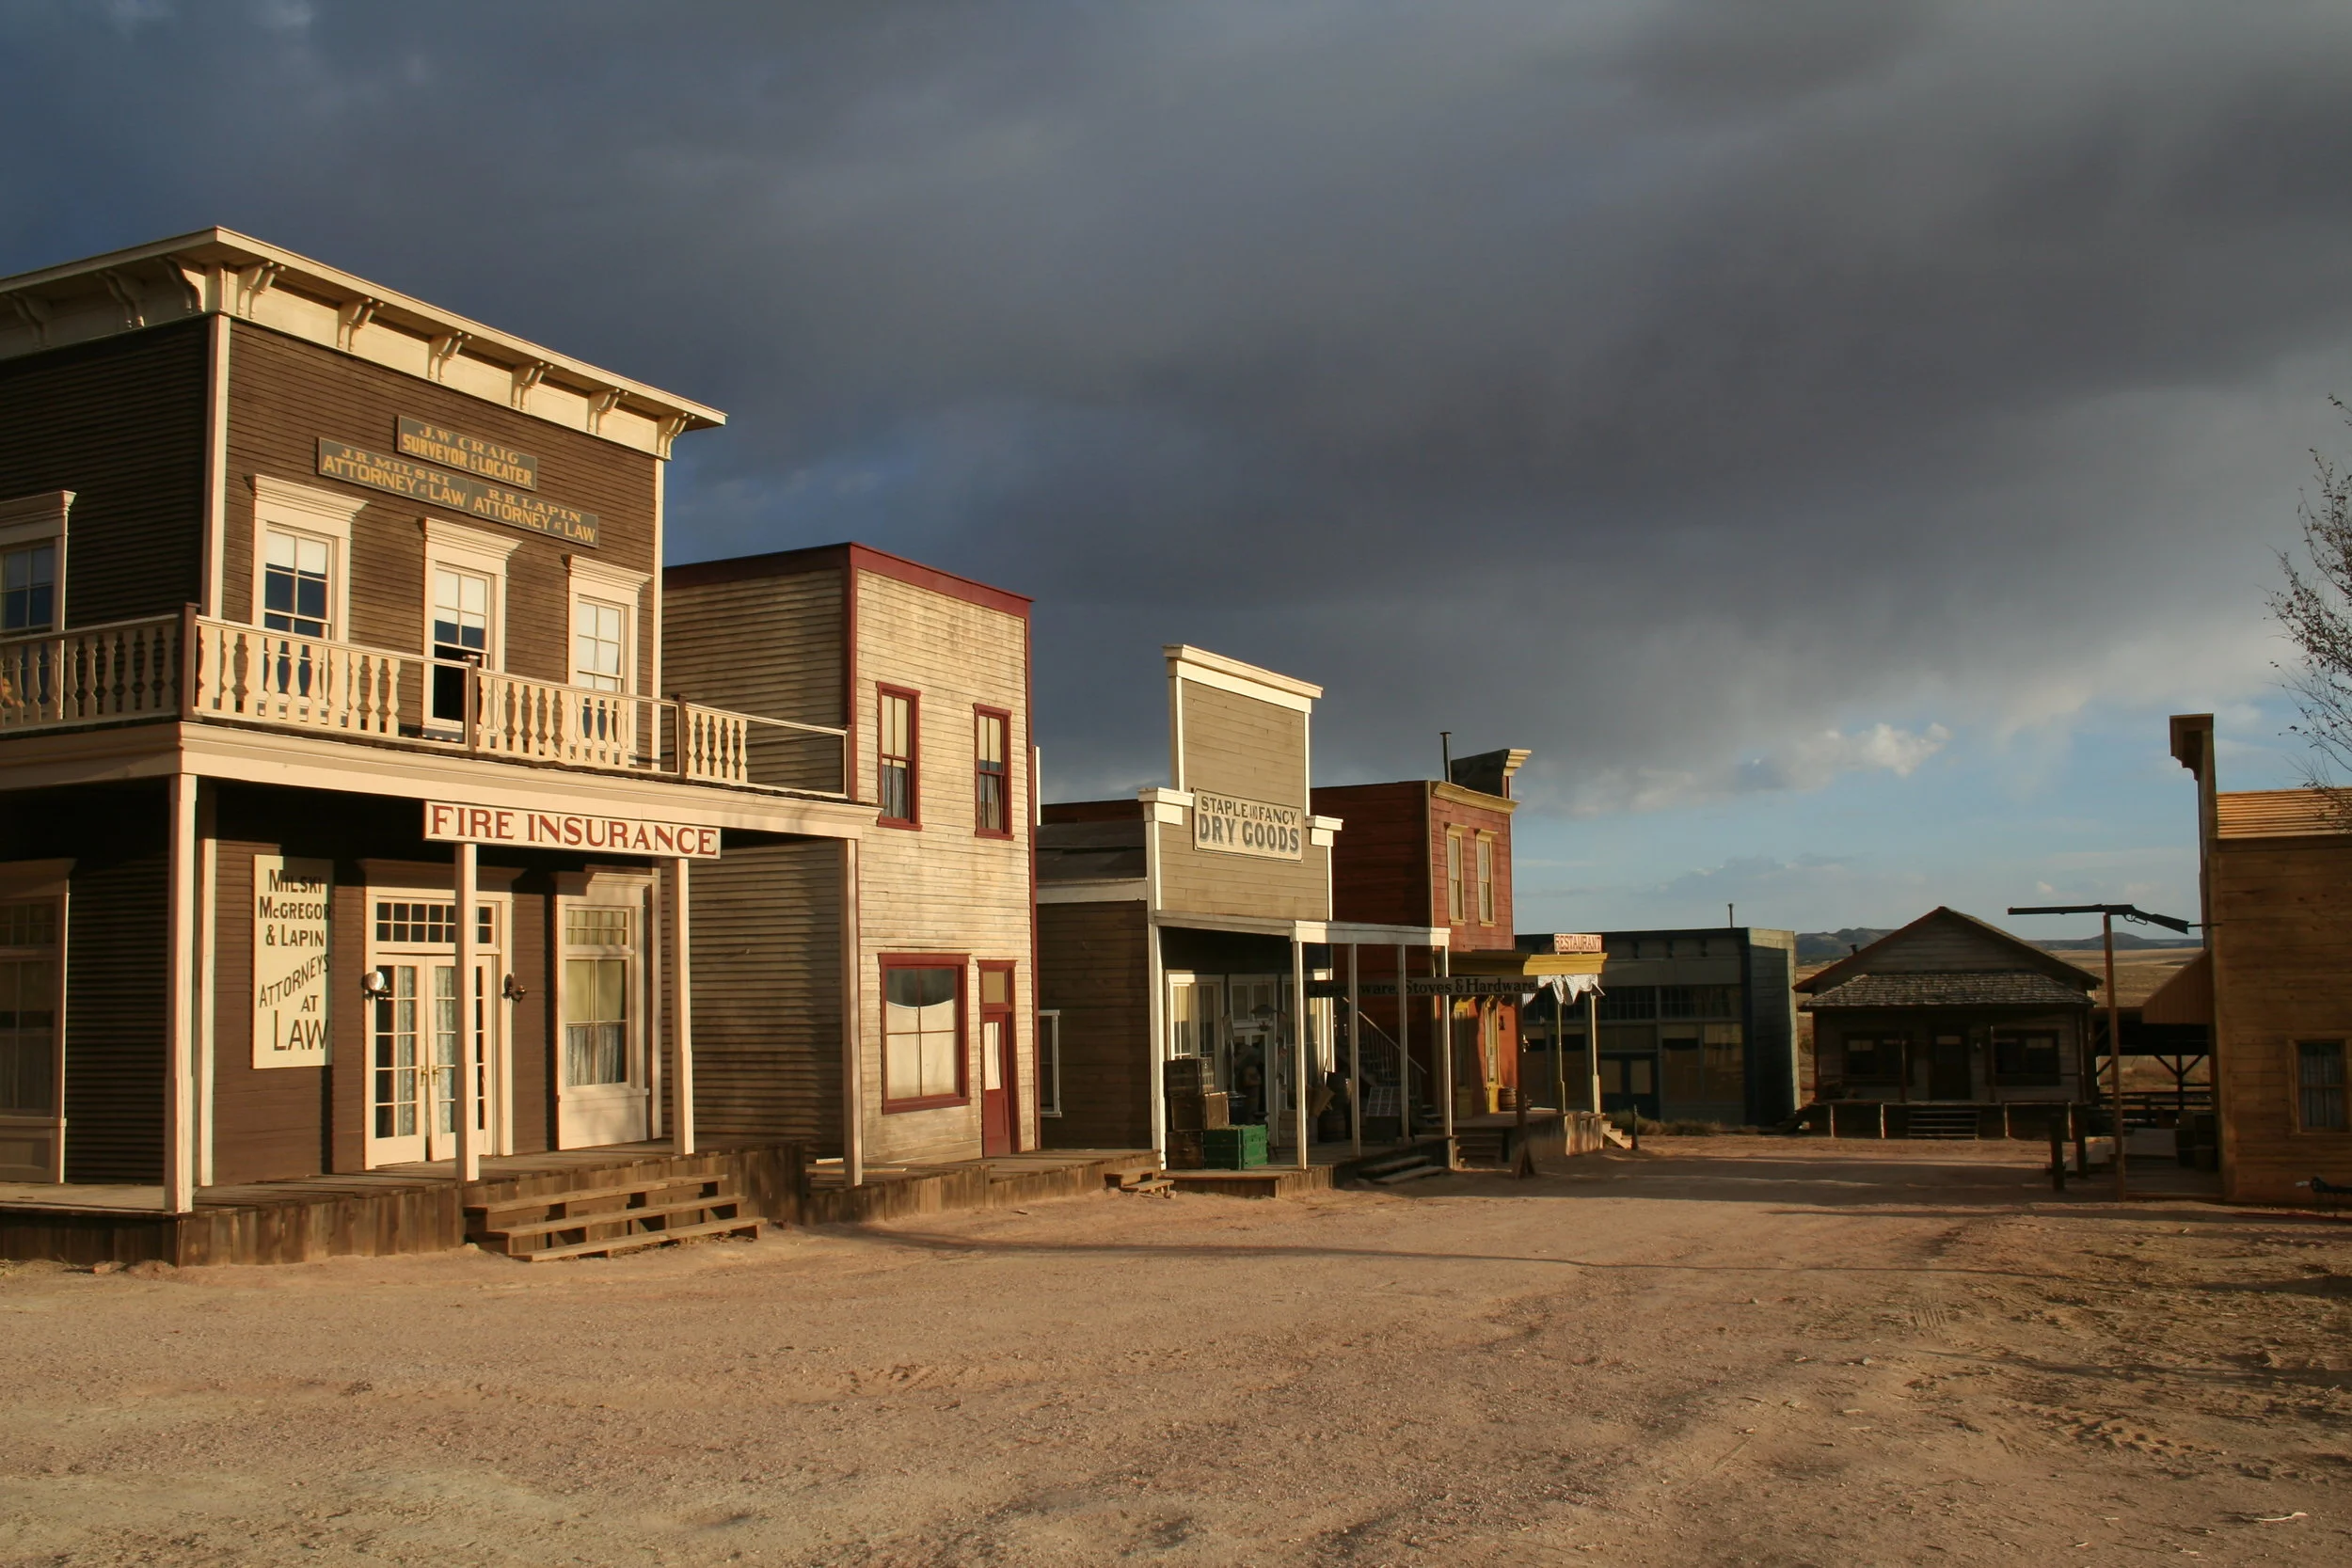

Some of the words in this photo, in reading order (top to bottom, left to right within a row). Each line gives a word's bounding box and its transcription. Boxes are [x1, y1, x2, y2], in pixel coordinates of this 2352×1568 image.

[402, 433, 468, 467] SURVEYOR
[478, 456, 533, 487] LOCATER
[458, 436, 519, 465] CRAIG
[322, 454, 417, 494] ATTORNEY
[429, 483, 467, 507] LAW
[374, 457, 450, 486] MILSKI
[473, 496, 550, 531] ATTORNEY
[564, 521, 596, 543] LAW
[522, 498, 581, 523] LAPIN
[1200, 796, 1248, 818] STAPLE
[1259, 807, 1297, 826] FANCY
[431, 804, 516, 840] FIRE
[527, 813, 719, 857] INSURANCE
[1199, 813, 1236, 845] DRY
[1242, 819, 1300, 854] GOODS
[269, 869, 323, 894] MILSKI
[259, 895, 332, 921] McGREGOR
[265, 924, 276, 946] &
[280, 924, 325, 947] LAPIN
[1554, 934, 1602, 951] RESTAURANT
[259, 954, 330, 1008] ATTORNEYS
[1455, 977, 1463, 993] &
[301, 994, 319, 1012] AT
[274, 1009, 329, 1051] LAW
